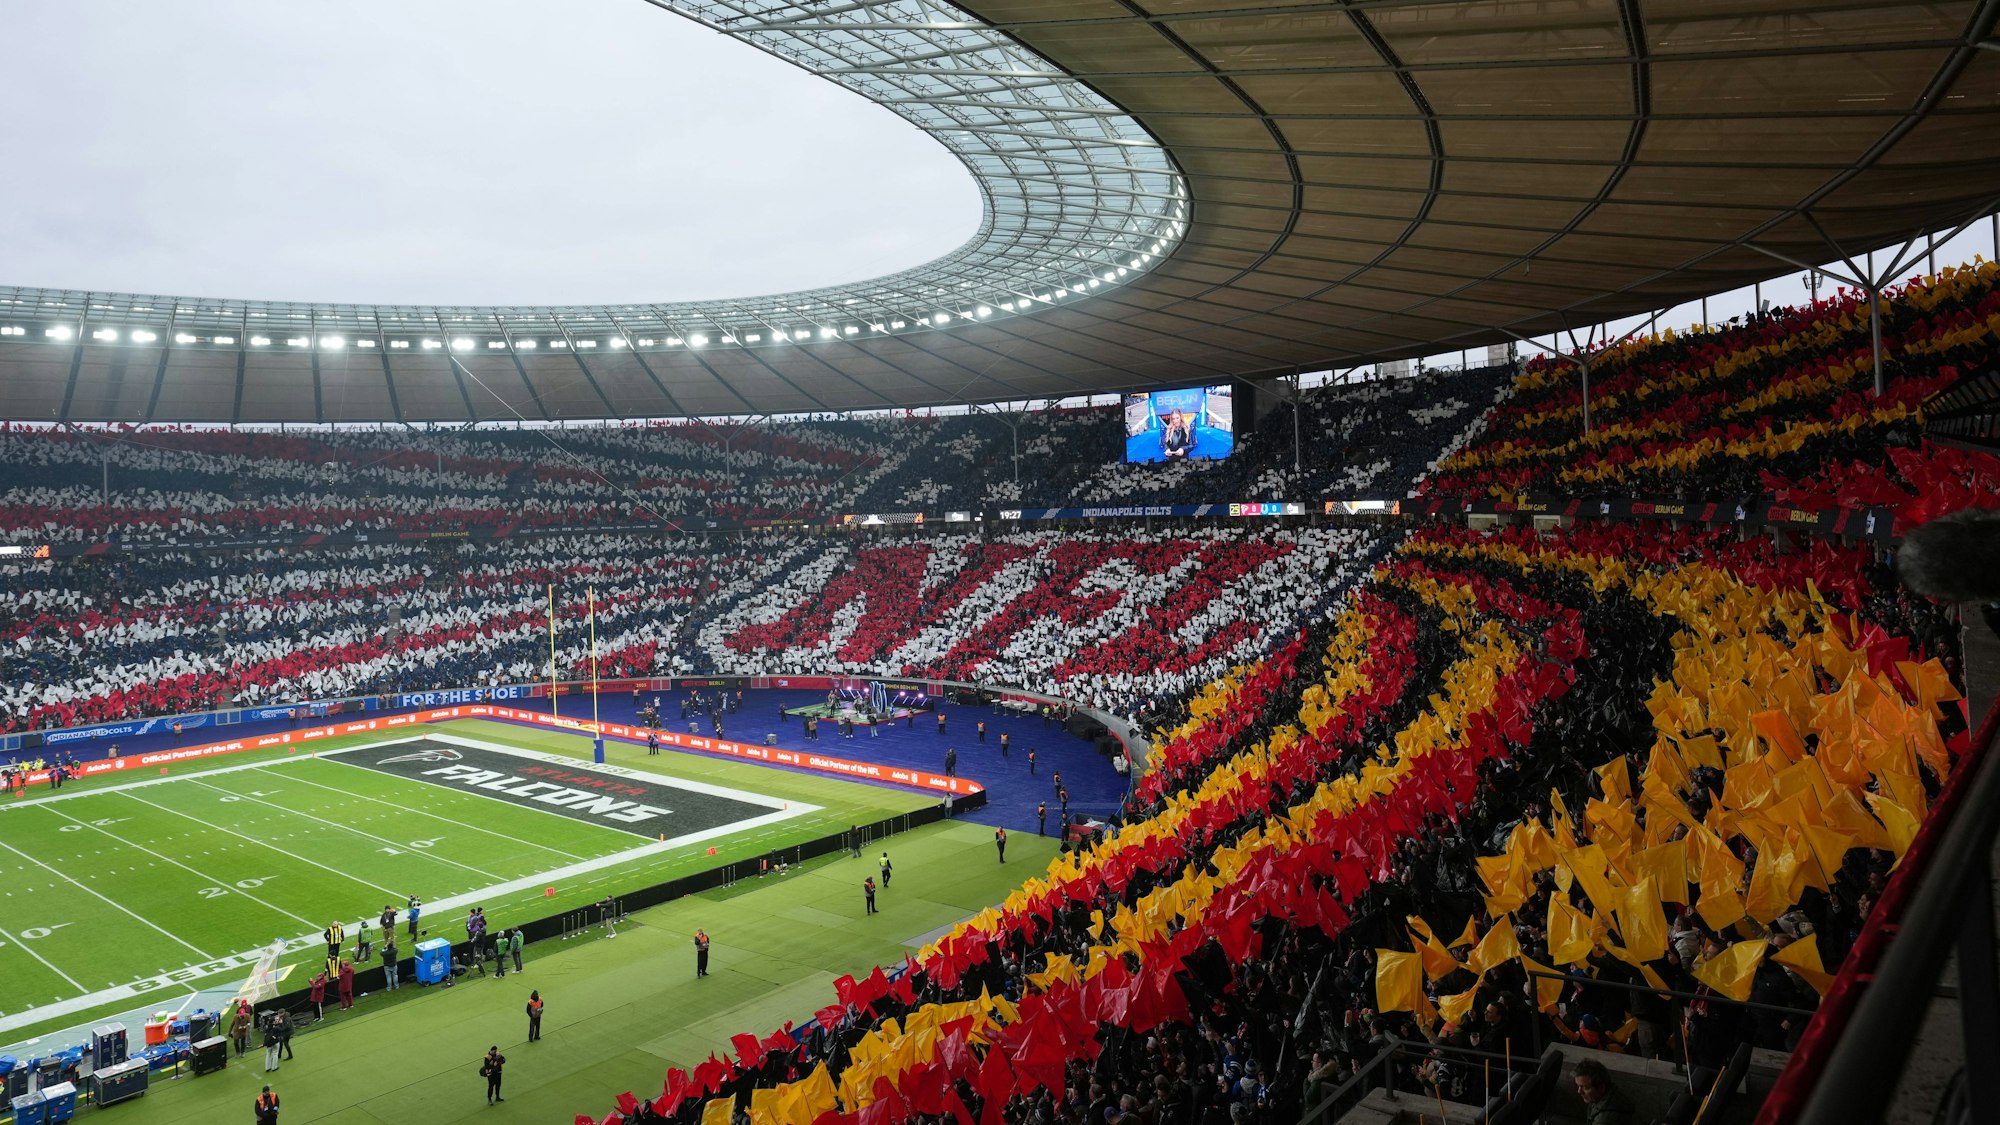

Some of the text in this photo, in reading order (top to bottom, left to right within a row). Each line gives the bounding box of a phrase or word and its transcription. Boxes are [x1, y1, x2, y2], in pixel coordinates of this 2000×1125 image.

[1156, 393, 1198, 406] BERLIN
[1082, 506, 1172, 517] INDIANAPOLIS COLTS
[1534, 503, 1547, 512] GAME
[1655, 504, 1670, 514] BERLIN
[1671, 505, 1684, 514] GAME
[1000, 511, 1021, 520] 19:27
[1790, 509, 1804, 522] BERLIN
[1804, 512, 1819, 523] GAME
[402, 690, 435, 708] FOR
[439, 690, 471, 705] THE
[388, 716, 407, 725] Adobe
[347, 723, 366, 732] Adobe
[50, 726, 133, 741] INDIANAPOLIS COLTS
[304, 730, 324, 738] Adobe
[661, 734, 674, 742] Adobe
[258, 737, 280, 746] Adobe
[691, 739, 704, 747] Adobe
[718, 743, 732, 751] Adobe
[747, 747, 761, 756] Adobe
[142, 742, 243, 764] Official Partner of the NFL
[777, 753, 792, 761] Adobe
[86, 763, 112, 772] Adobe
[809, 757, 881, 776] Official Partner of the NFL
[29, 771, 50, 782] Adob
[892, 771, 909, 780] Adobe
[517, 765, 650, 797] ATLANTA
[929, 778, 947, 787] Adobe
[420, 764, 674, 823] FALCONS
[197, 878, 264, 899] 20
